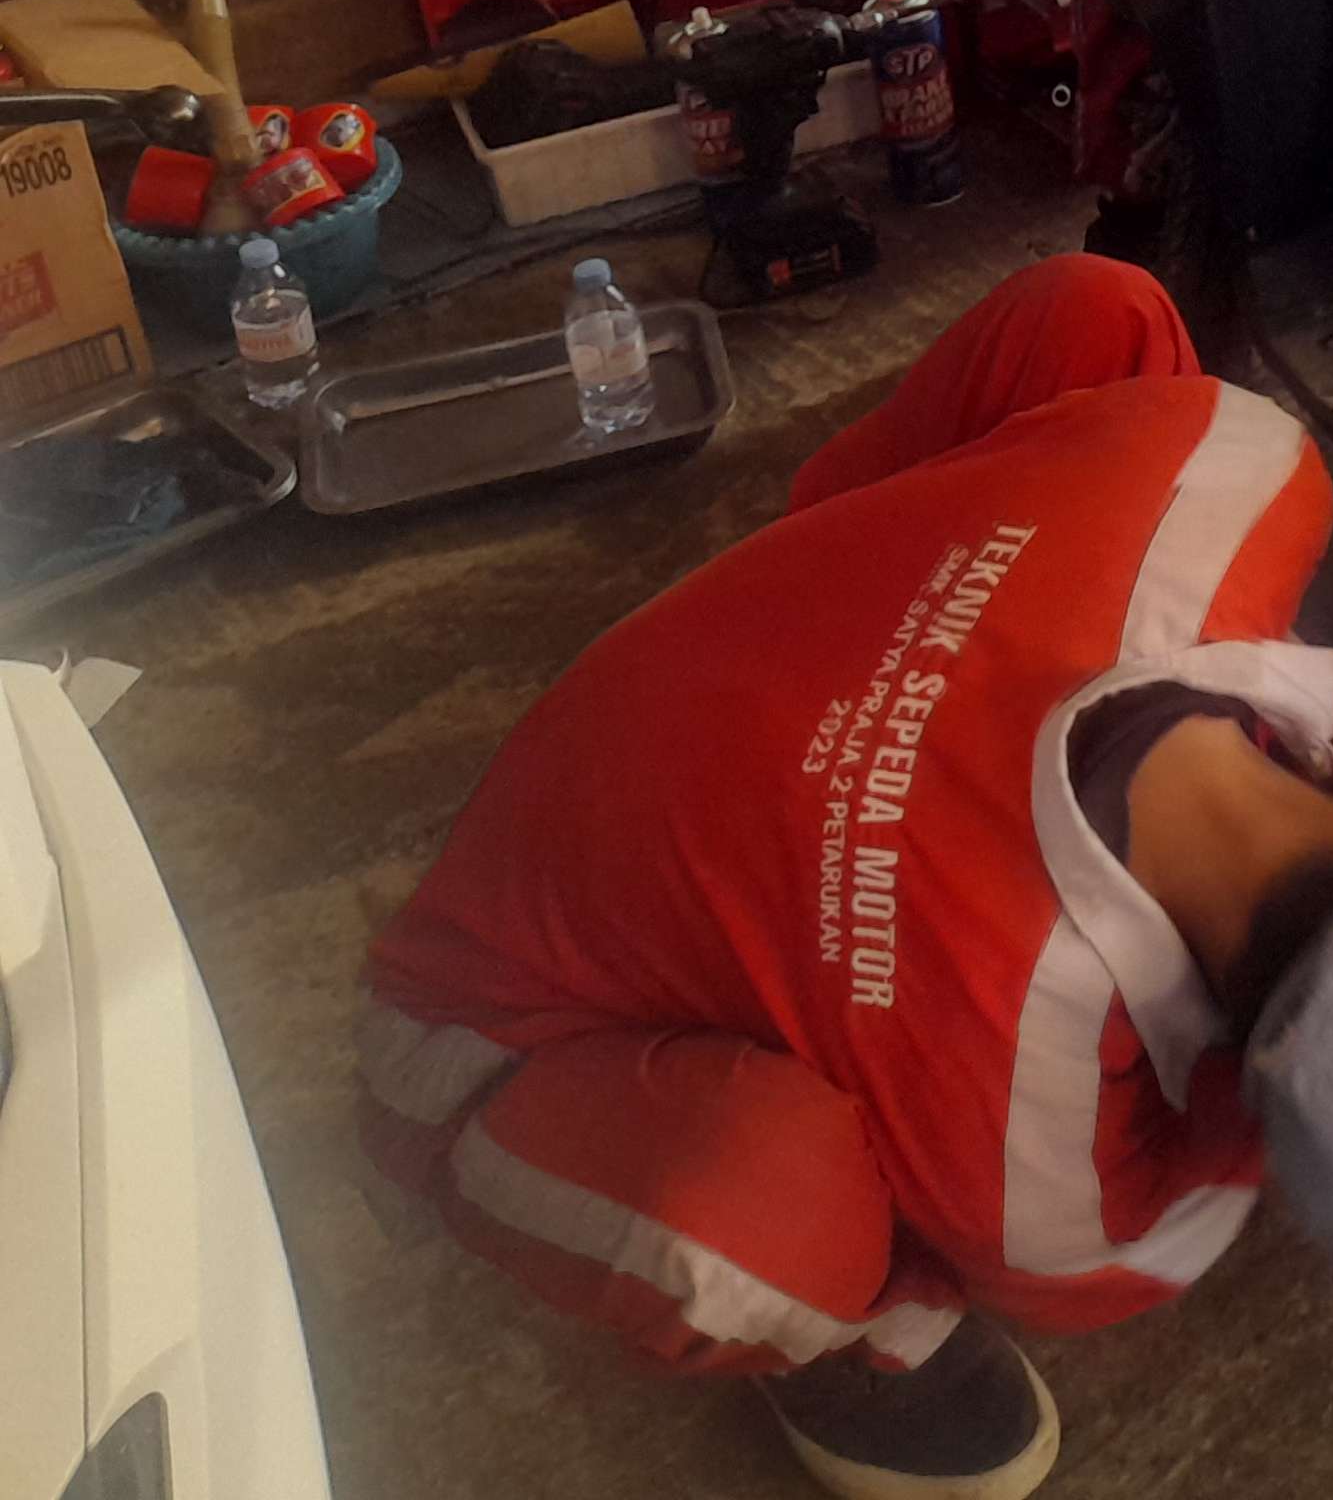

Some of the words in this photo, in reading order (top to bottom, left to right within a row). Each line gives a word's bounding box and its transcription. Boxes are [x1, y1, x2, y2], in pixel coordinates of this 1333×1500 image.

[0, 147, 72, 198] 19008
[920, 518, 1039, 655] TEKNIK
[878, 599, 931, 682] SATYA
[801, 697, 853, 776] 2023
[837, 679, 893, 780] PRAJA
[857, 668, 946, 827] SEPEDA
[828, 775, 853, 794] 2
[818, 800, 848, 964] PETARUKAN
[850, 846, 900, 1011] MOTOR
